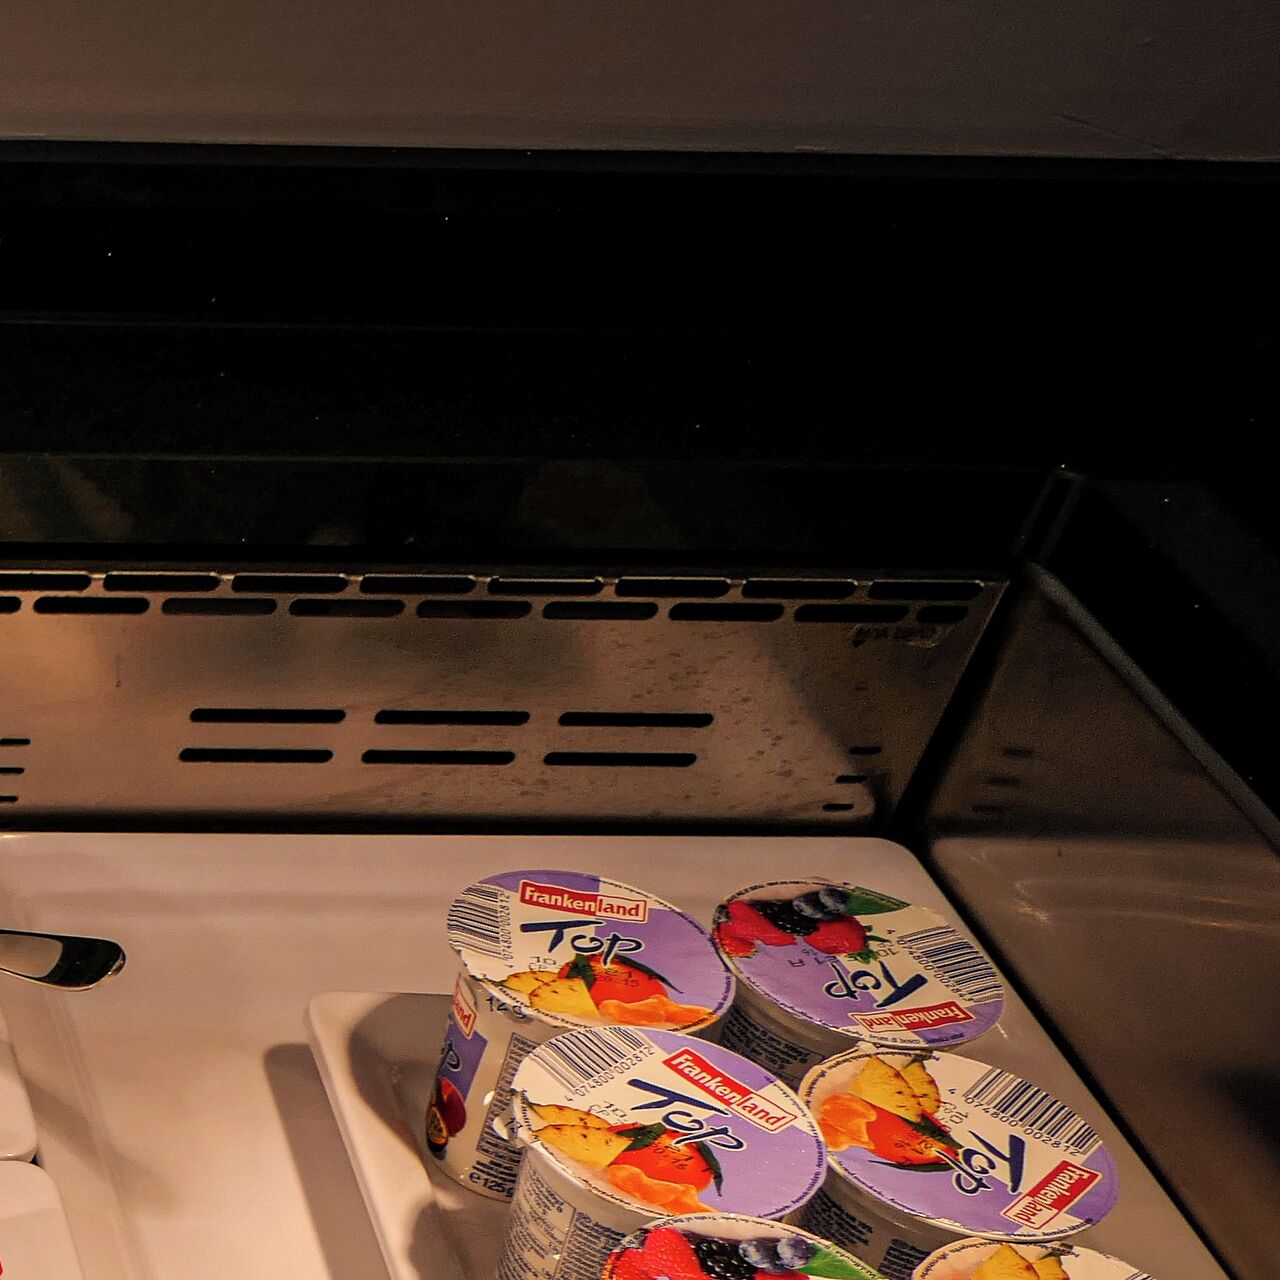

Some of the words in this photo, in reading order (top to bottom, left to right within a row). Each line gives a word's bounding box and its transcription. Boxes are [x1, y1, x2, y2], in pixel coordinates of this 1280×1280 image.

[525, 887, 640, 917] Frankenland
[520, 920, 645, 965] Top
[824, 962, 928, 1008] Top
[860, 1006, 967, 1029] Frankenland
[576, 1072, 614, 1097] 074800
[614, 1047, 654, 1075] 002812
[671, 1054, 788, 1128] Frankenland
[627, 1079, 747, 1151] Top
[965, 1096, 1020, 1128] 074800
[1024, 1127, 1081, 1156] 002812
[951, 1130, 1026, 1196] Top
[1015, 1164, 1091, 1225] Frankenland
